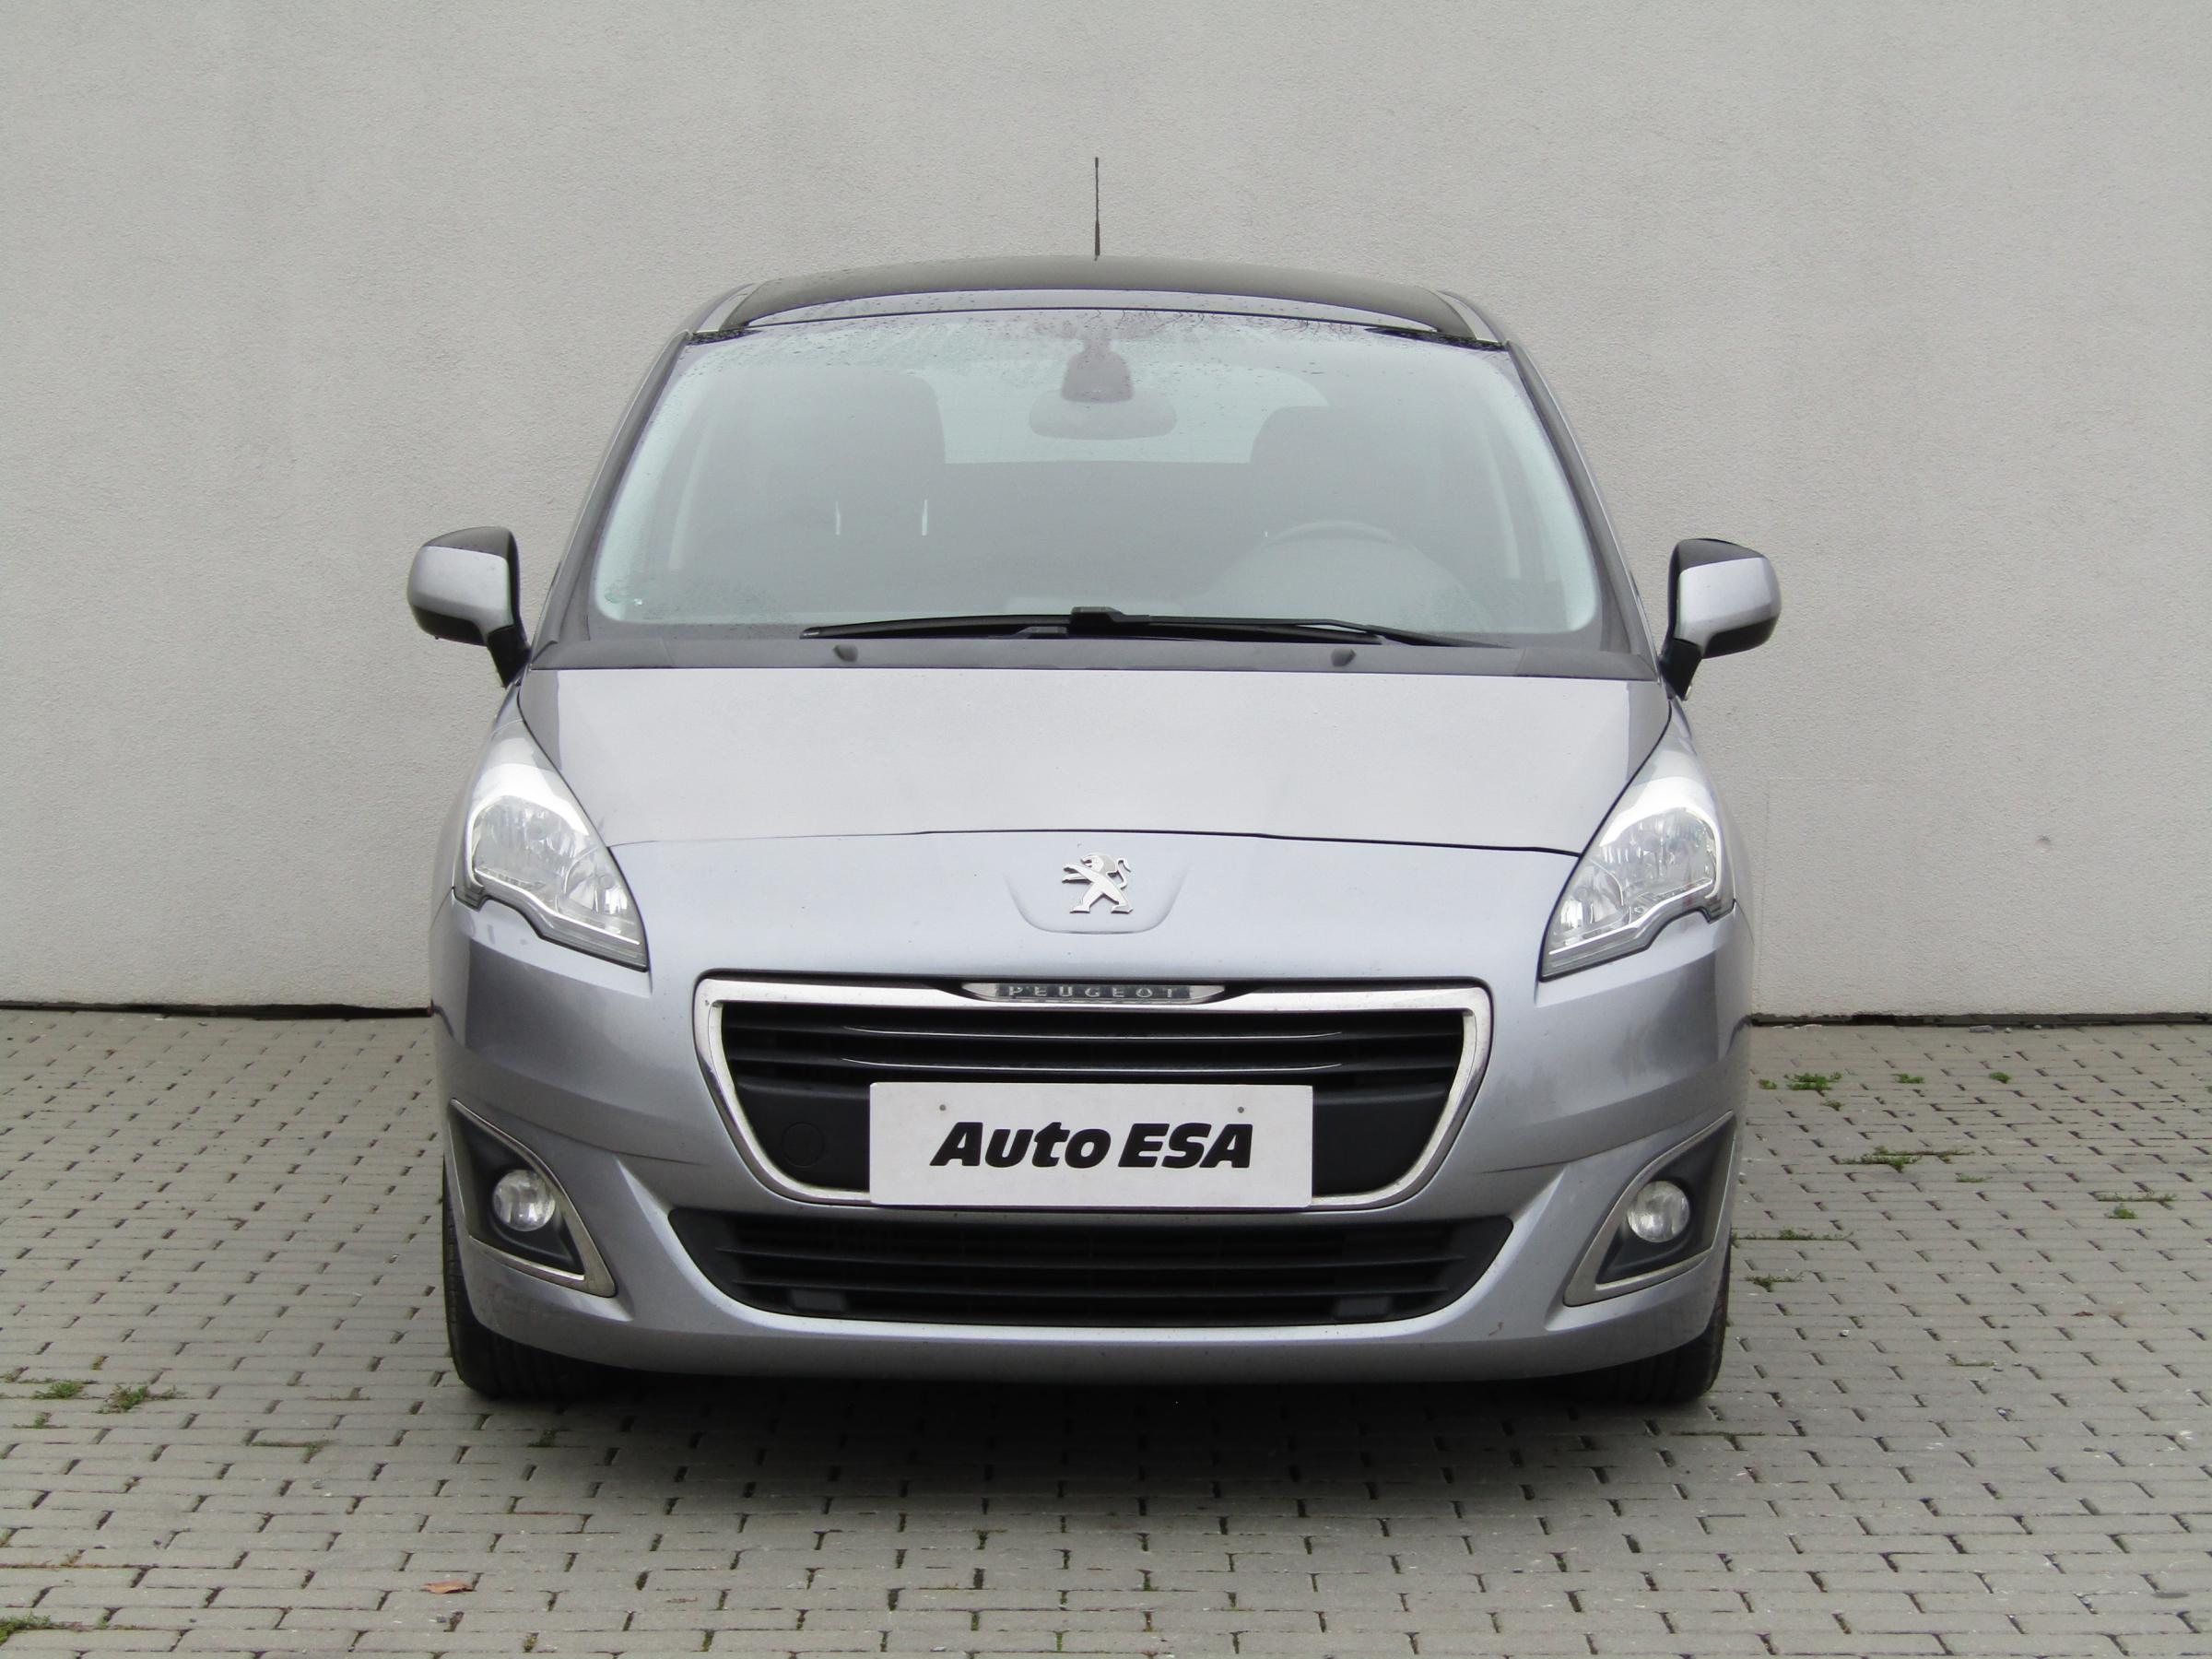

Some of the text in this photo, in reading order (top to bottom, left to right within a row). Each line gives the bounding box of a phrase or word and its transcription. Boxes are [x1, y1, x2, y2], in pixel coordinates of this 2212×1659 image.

[1008, 985, 1176, 998] PEUGEOT
[929, 1122, 1253, 1169] Auto ESA
